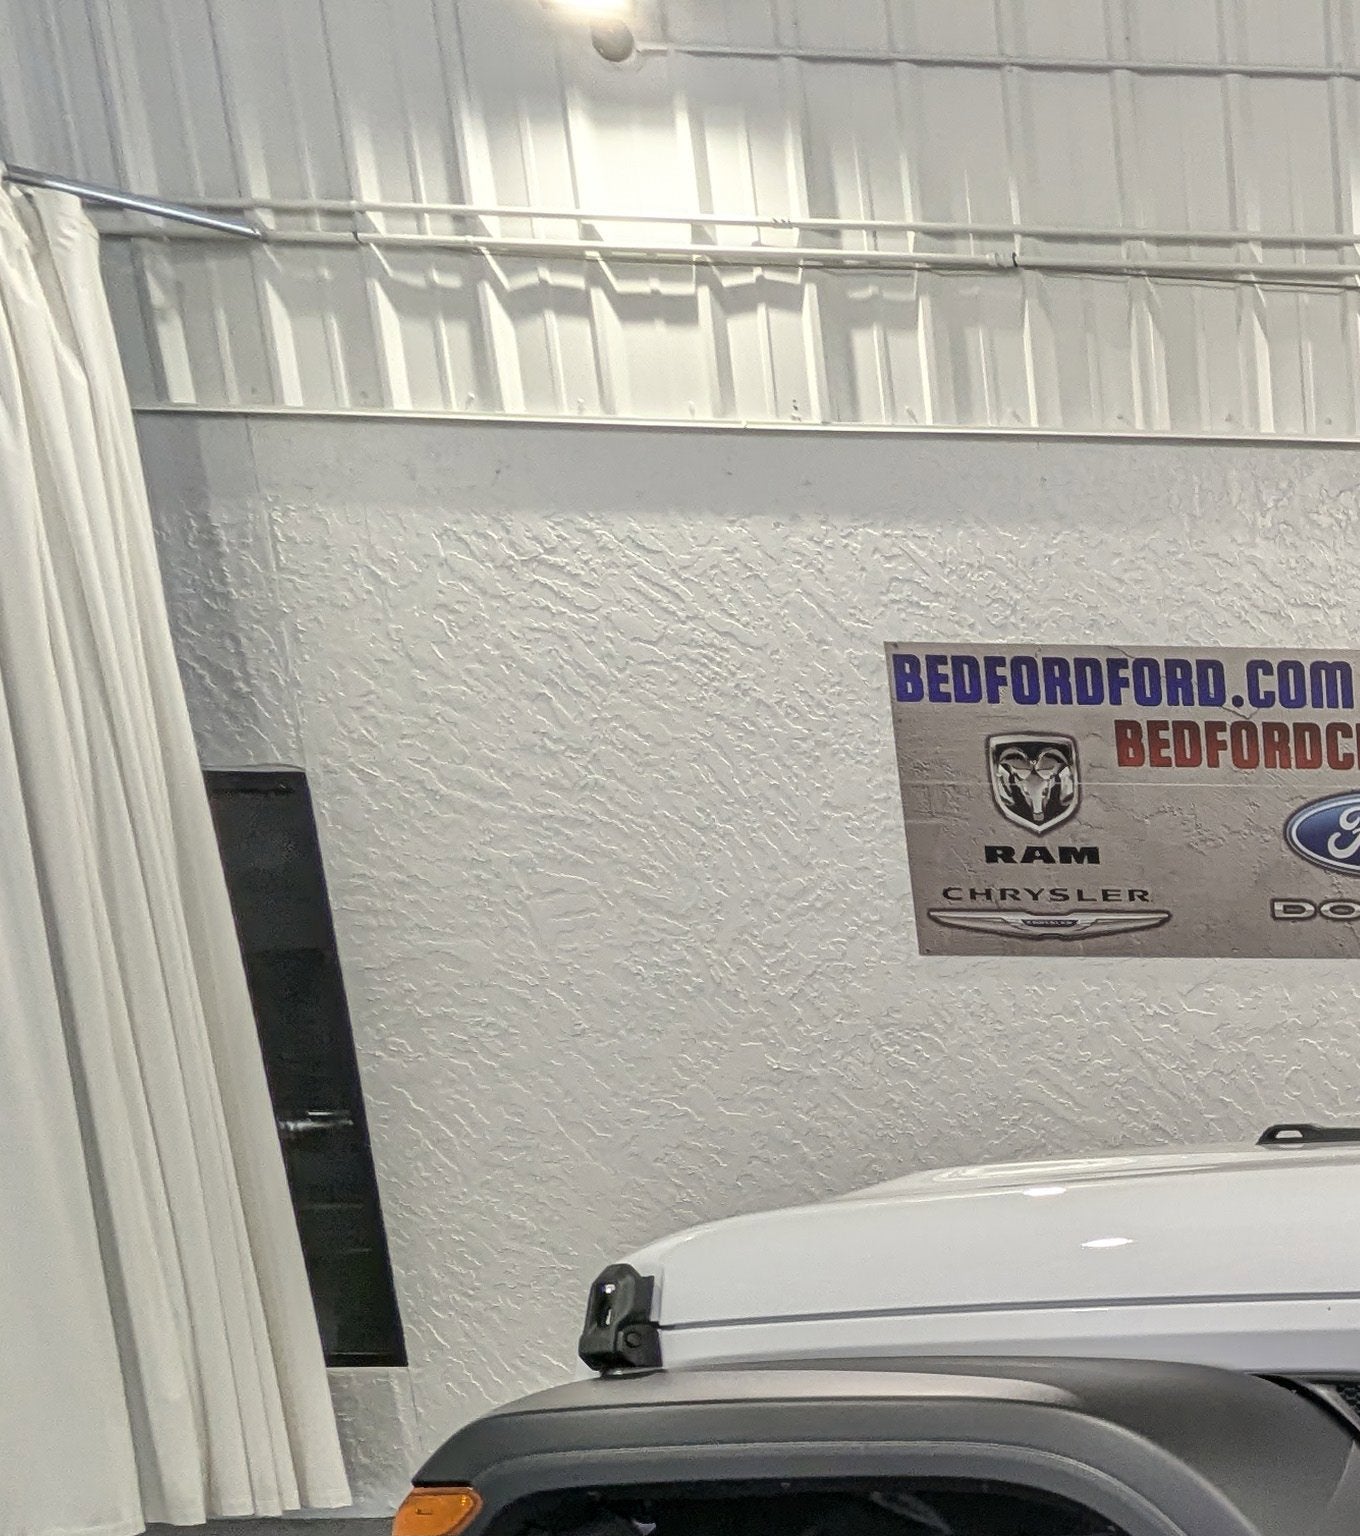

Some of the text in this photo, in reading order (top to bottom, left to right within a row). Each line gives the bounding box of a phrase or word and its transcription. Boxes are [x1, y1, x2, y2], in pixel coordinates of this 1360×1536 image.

[892, 653, 1355, 710] BEDFORDFORD.COM
[984, 845, 1101, 865] RAM
[942, 886, 1151, 903] CHRYSLER
